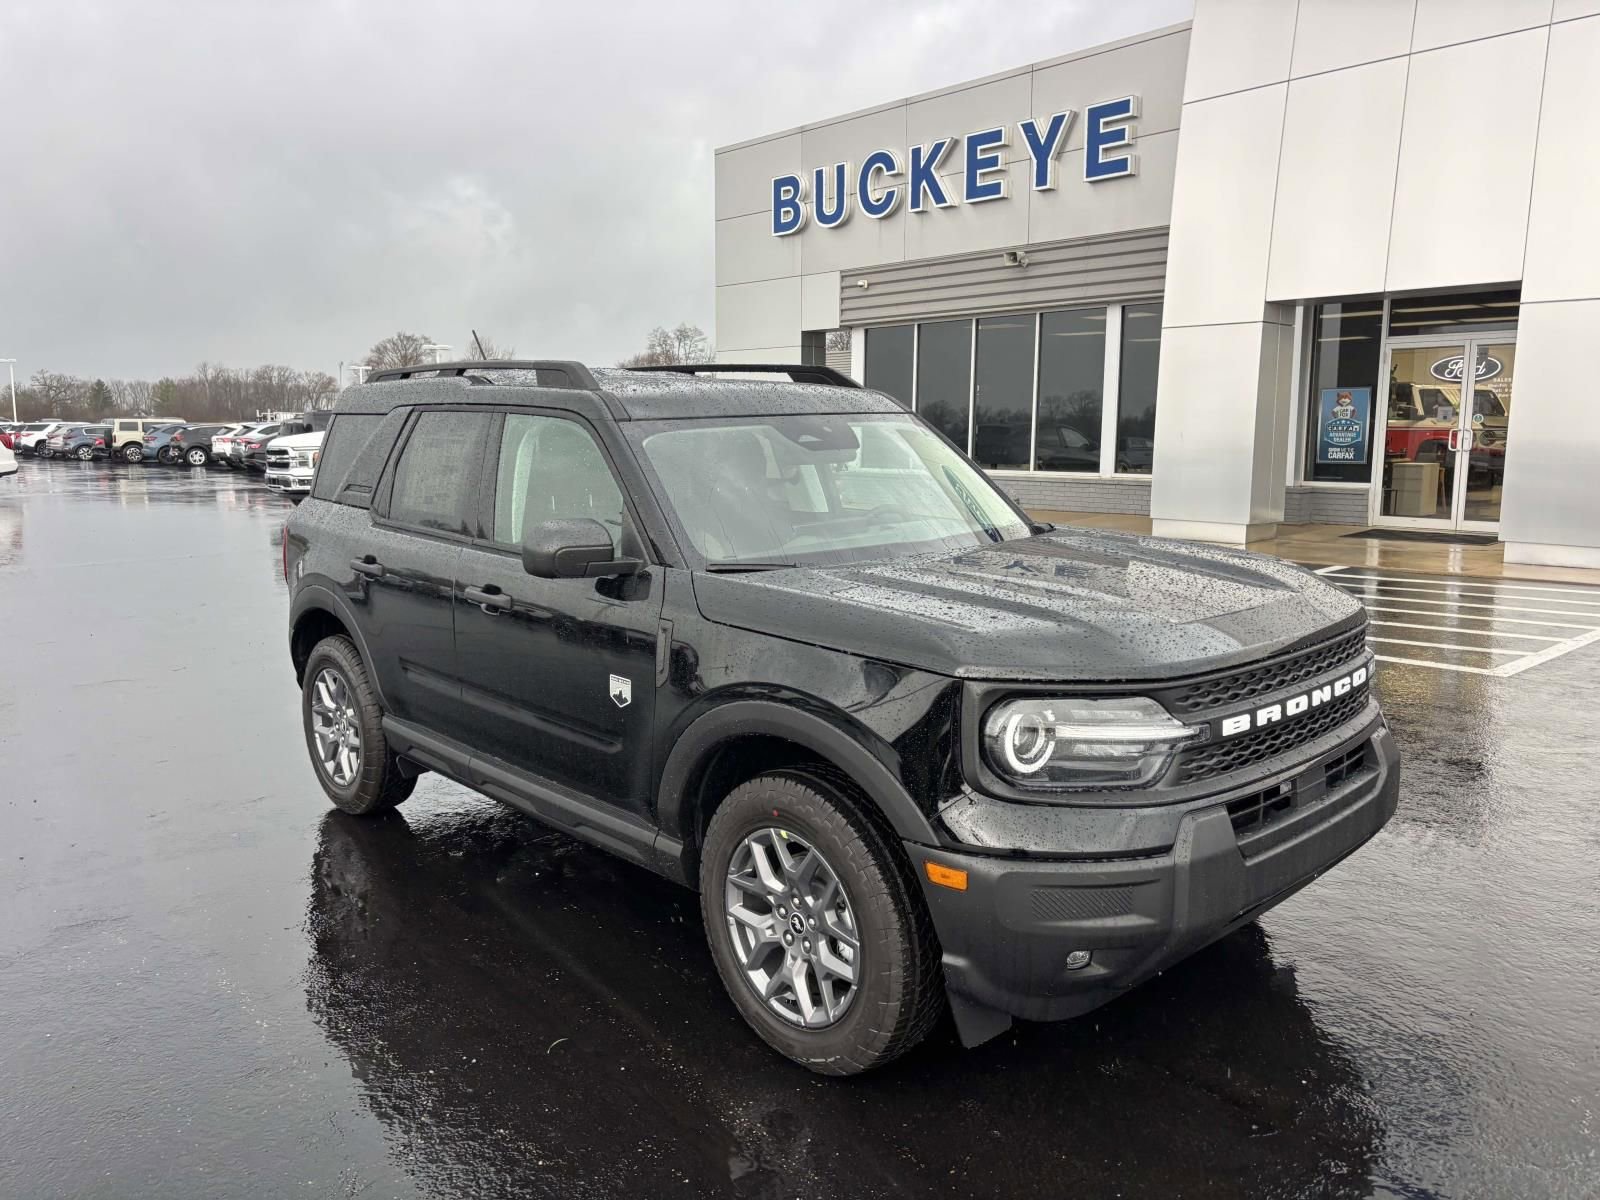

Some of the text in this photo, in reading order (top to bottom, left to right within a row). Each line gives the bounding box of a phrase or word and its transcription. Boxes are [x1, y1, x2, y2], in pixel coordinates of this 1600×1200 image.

[772, 95, 1140, 238] BUCKEYE
[1444, 360, 1486, 377] Fod
[1222, 668, 1366, 736] BRONCO
